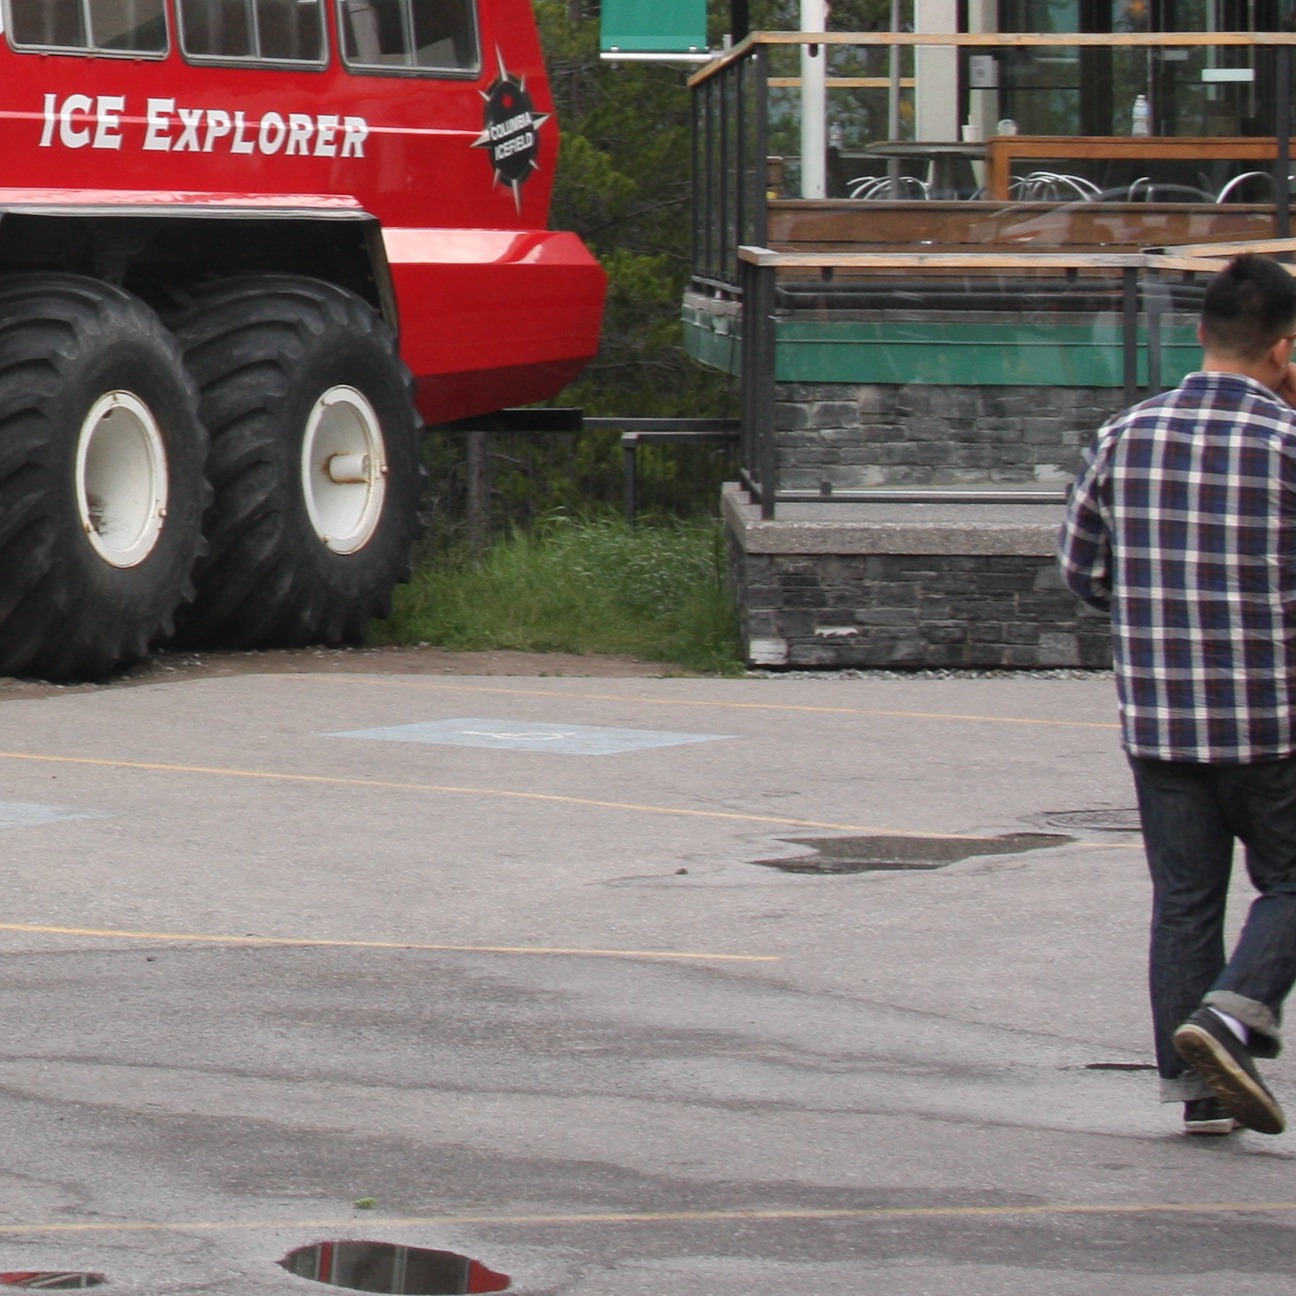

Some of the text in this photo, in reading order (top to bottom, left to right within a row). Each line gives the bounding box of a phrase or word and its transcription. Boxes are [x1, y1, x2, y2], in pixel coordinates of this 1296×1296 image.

[39, 93, 370, 158] ICE EXPLORER
[490, 111, 533, 140] COLUMBIA
[494, 132, 534, 161] ICEFIELD
